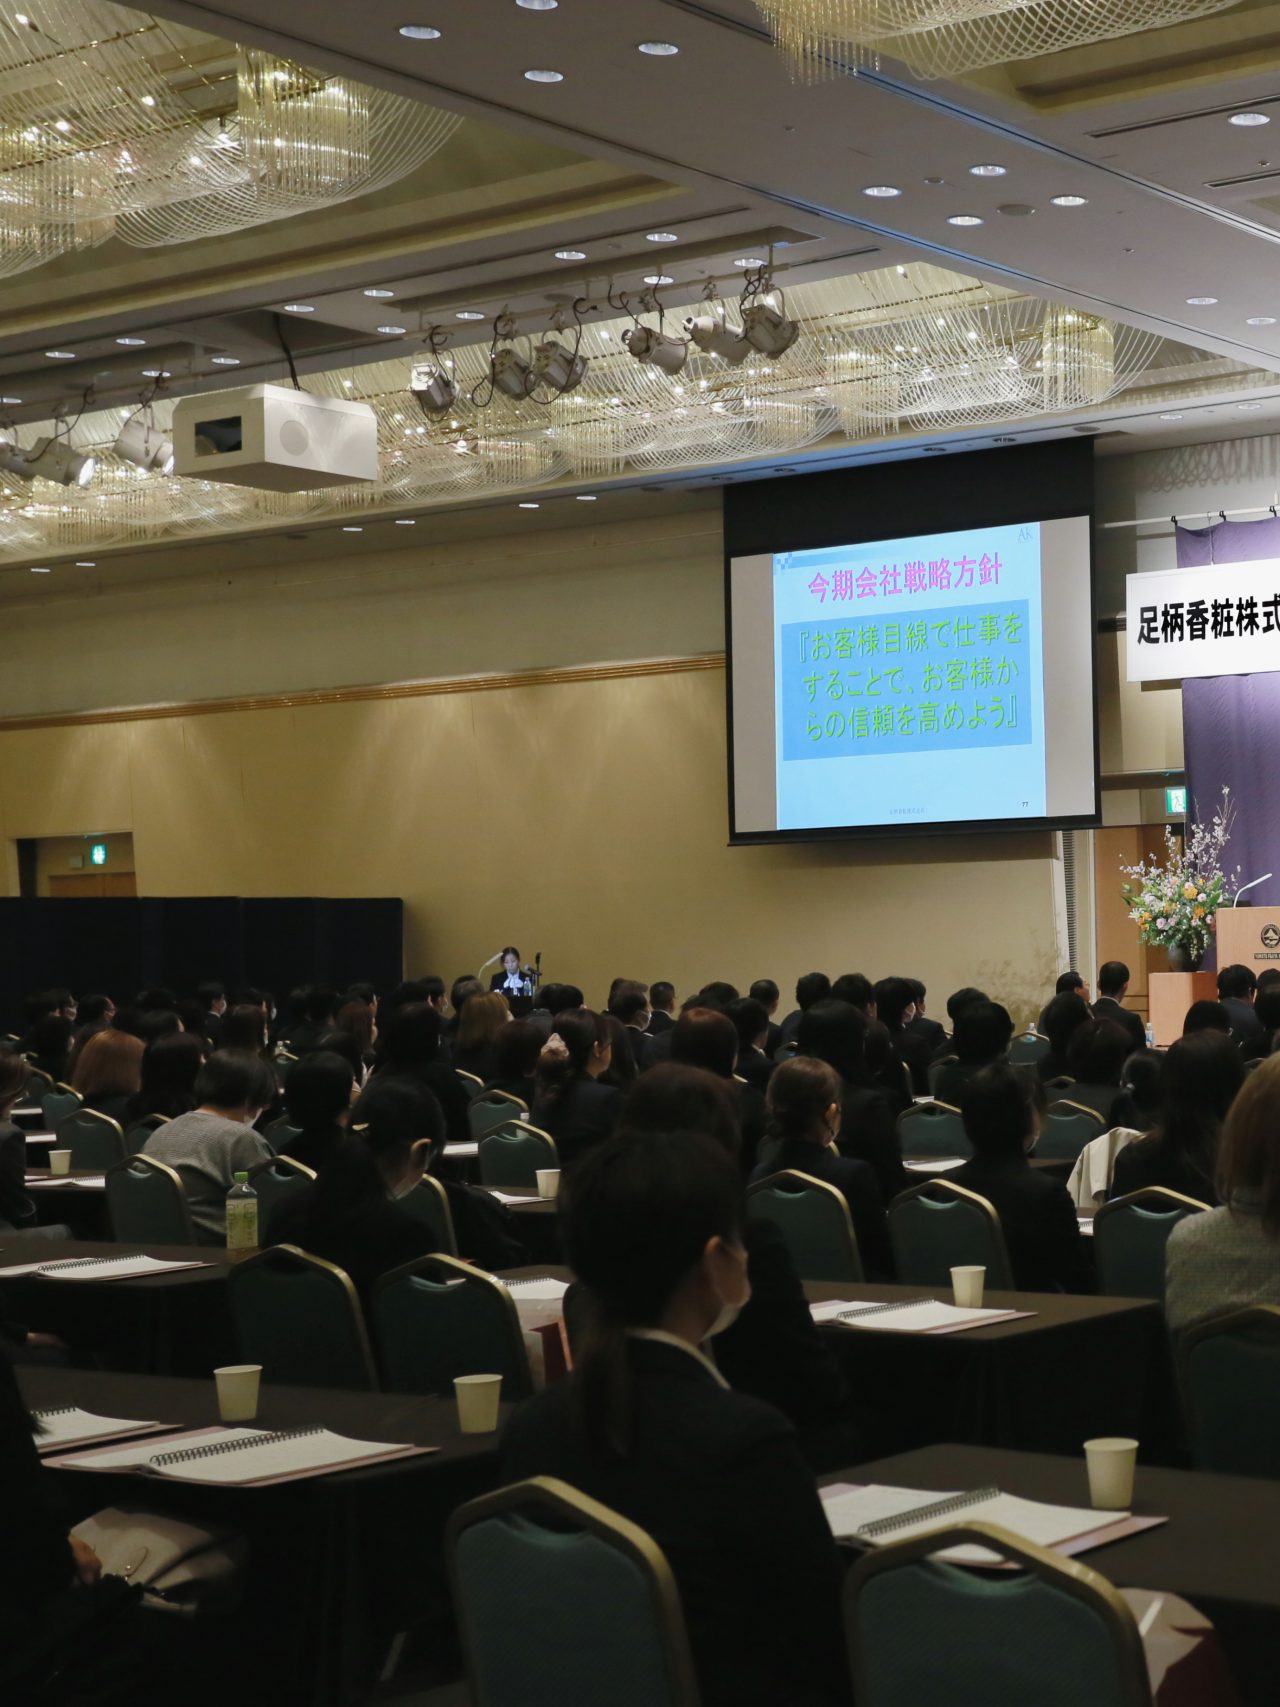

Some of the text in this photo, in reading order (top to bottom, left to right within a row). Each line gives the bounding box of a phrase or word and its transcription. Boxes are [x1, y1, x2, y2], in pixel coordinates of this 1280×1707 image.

[808, 552, 1003, 602] 今期会社戦略方針
[800, 611, 1022, 662] 『お客様目線で仕事を
[803, 655, 1019, 702] することで、お客様か
[805, 694, 1016, 741] らの信頼を高めよう』
